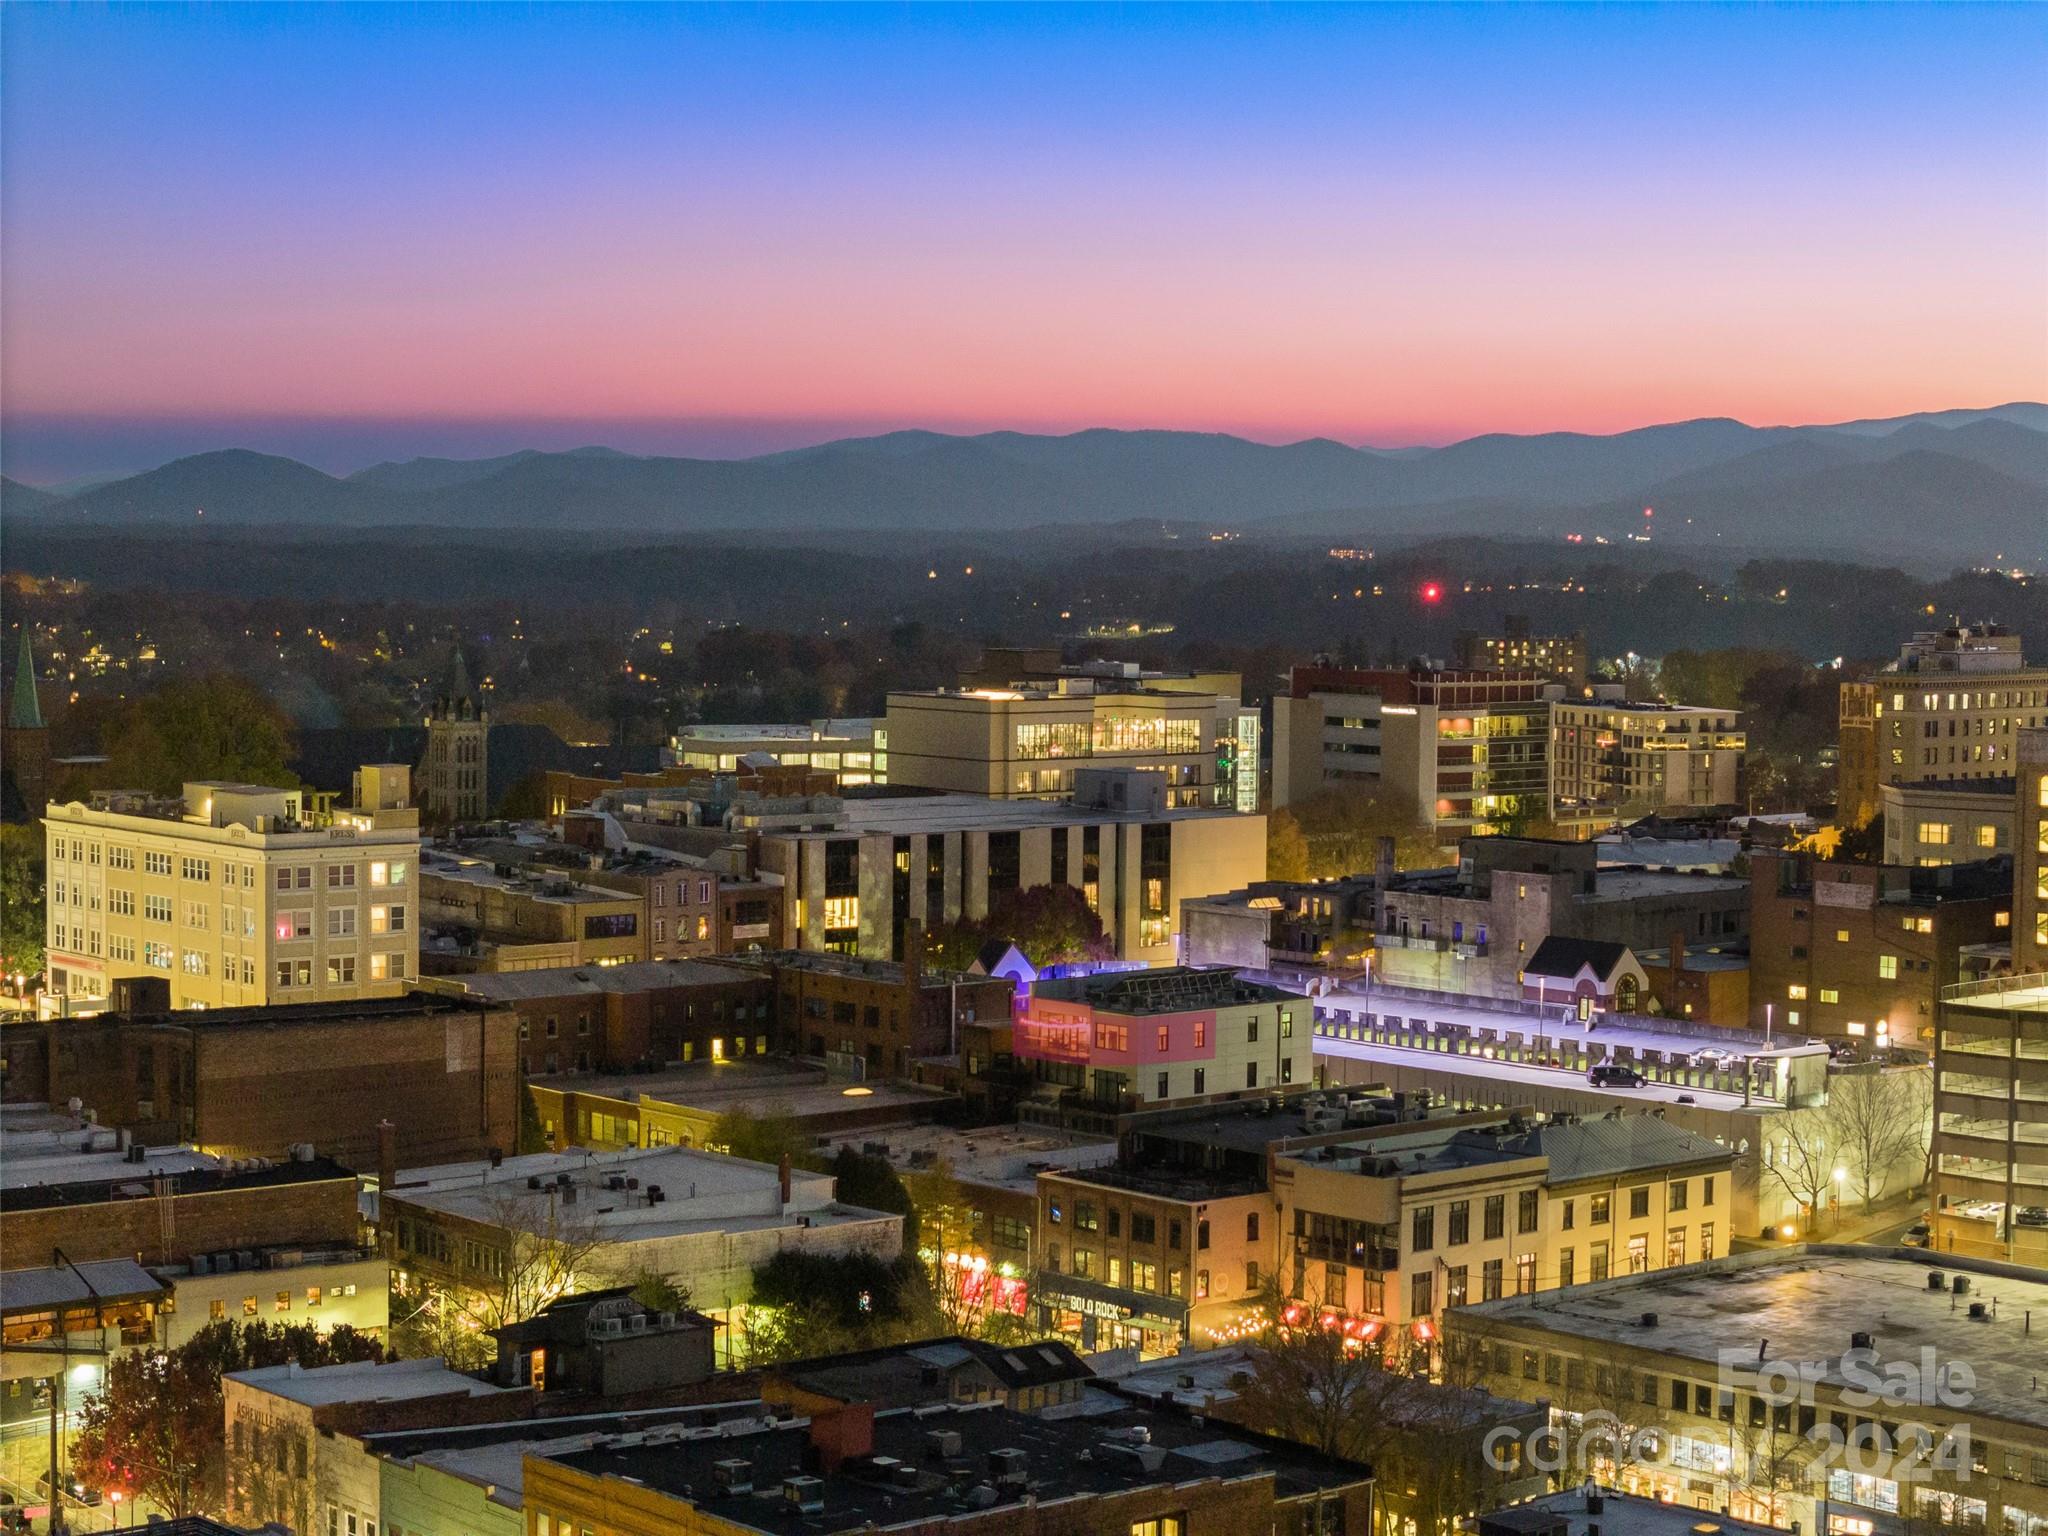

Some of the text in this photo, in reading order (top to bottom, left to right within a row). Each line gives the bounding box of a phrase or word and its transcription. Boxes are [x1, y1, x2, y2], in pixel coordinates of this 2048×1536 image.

[1070, 1295, 1119, 1320] BOLD ROCK
[236, 1401, 275, 1429] ASHEVILLE
